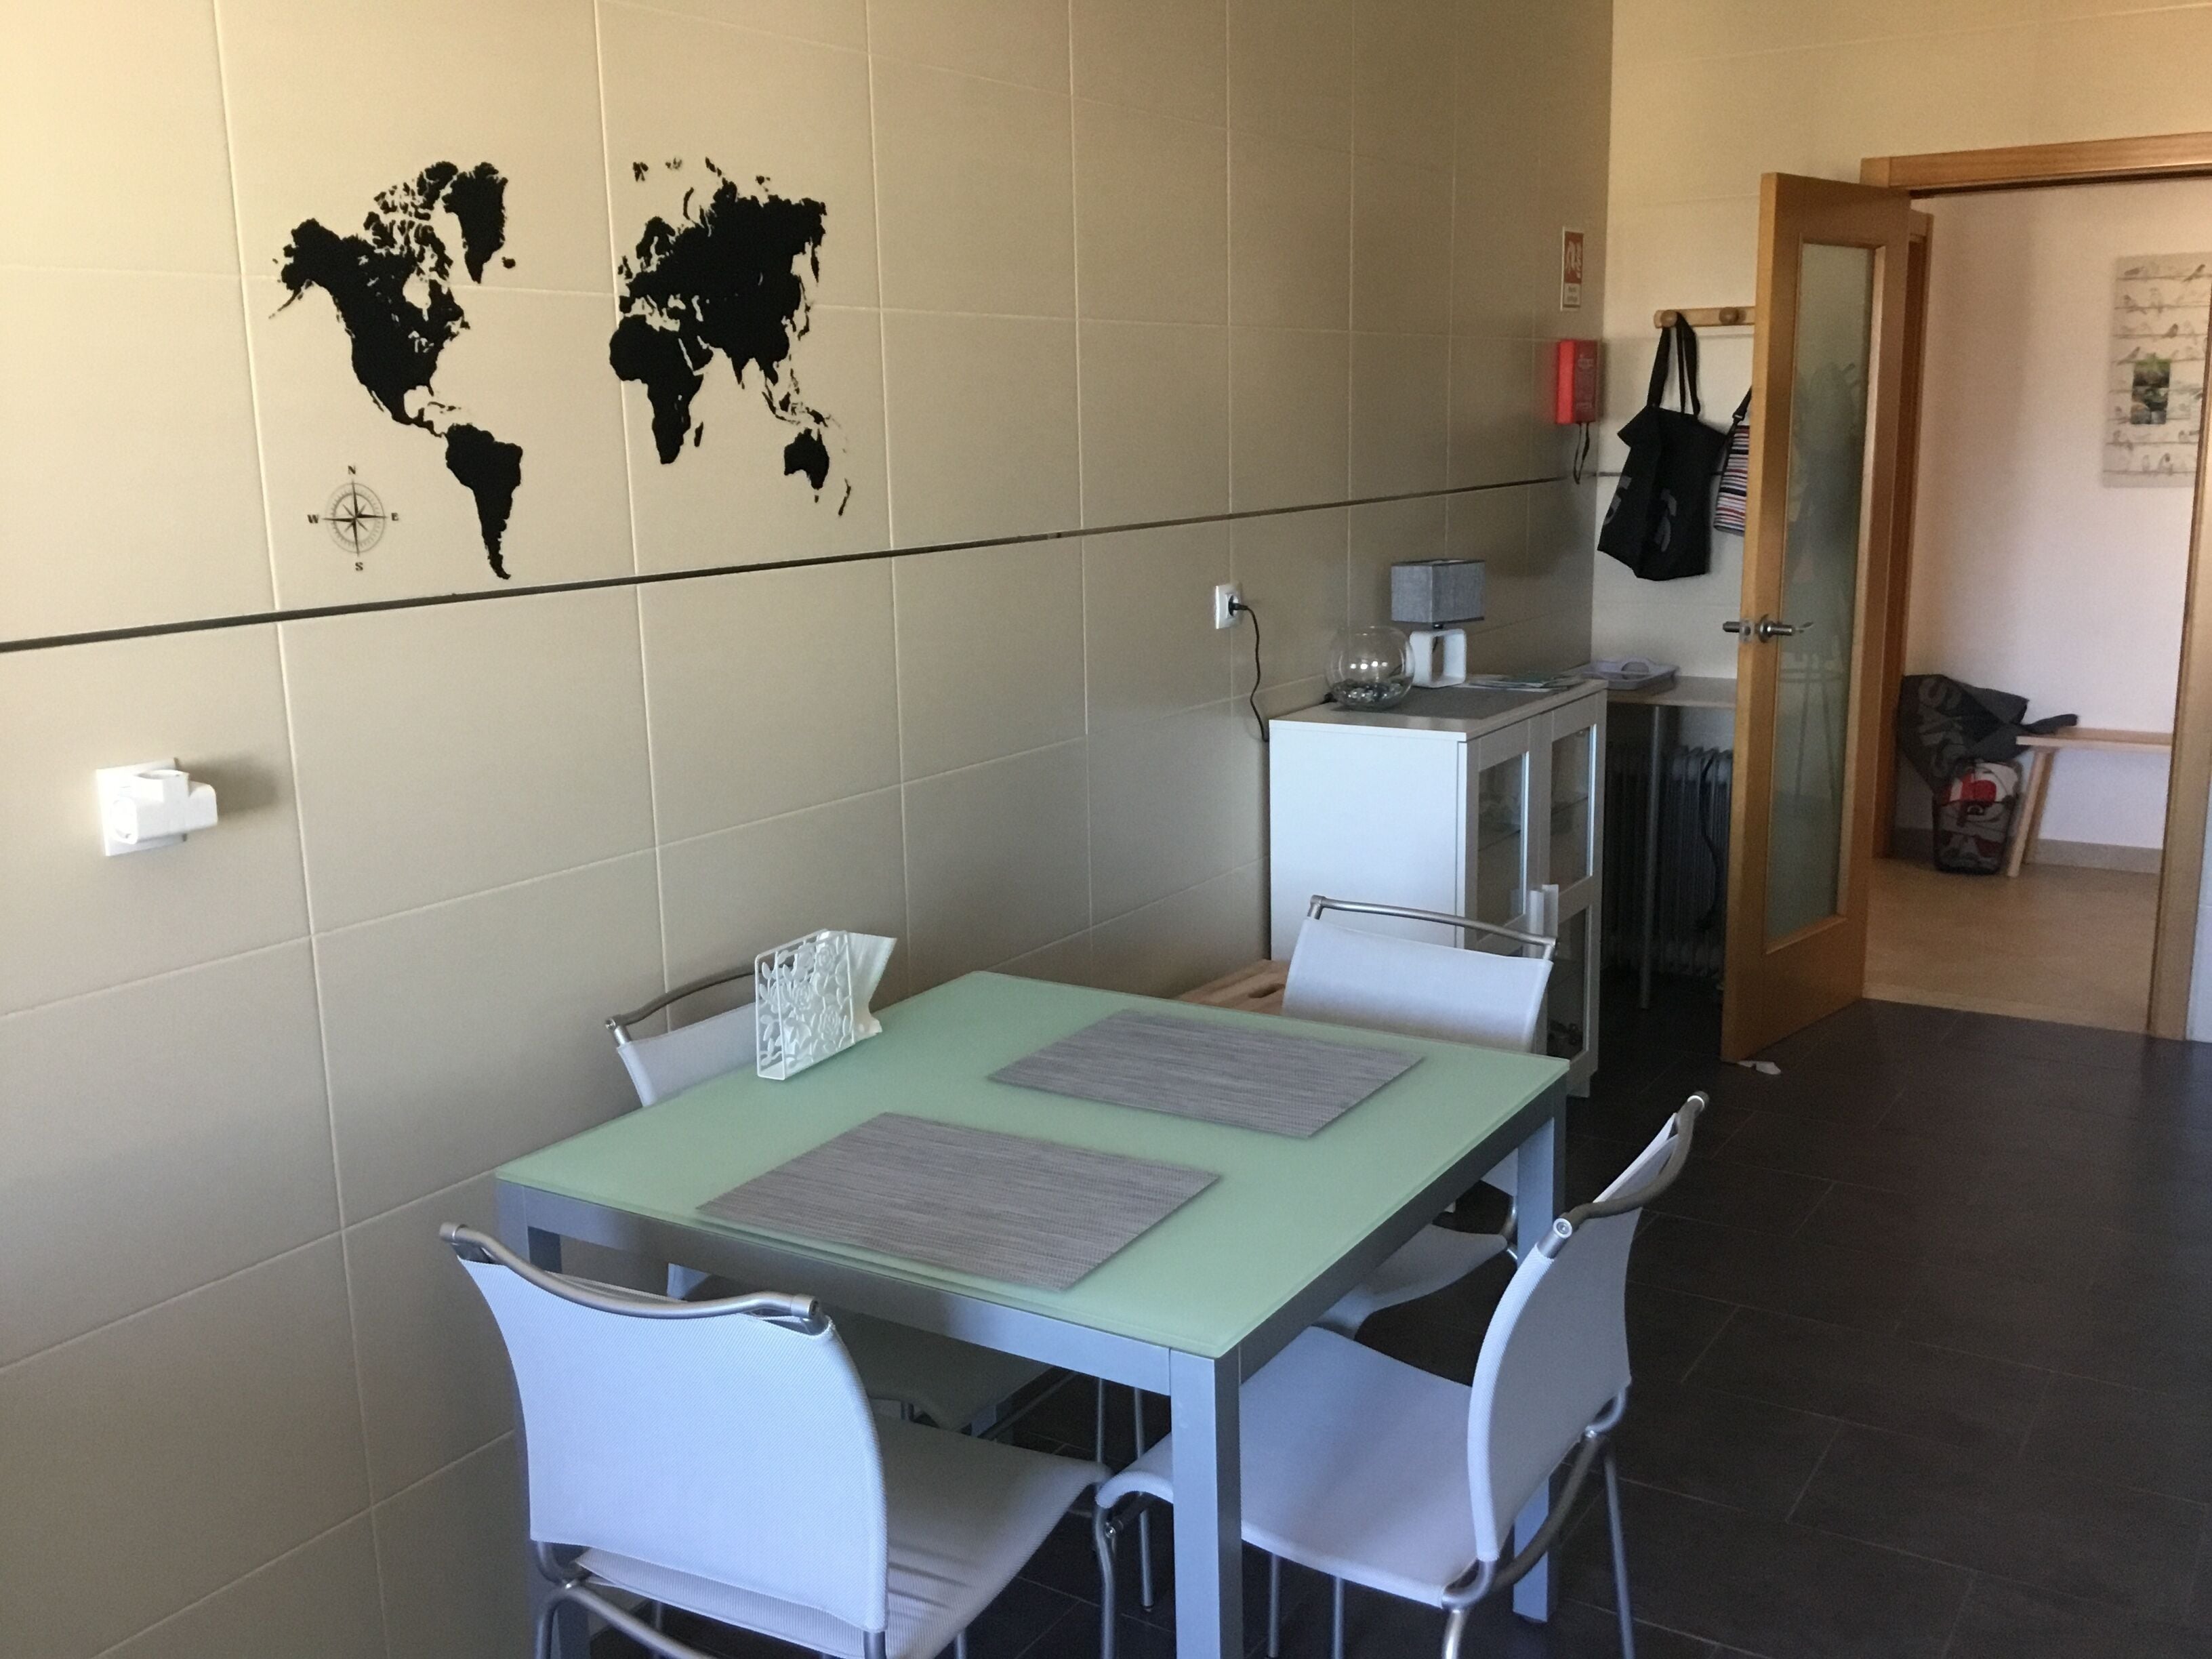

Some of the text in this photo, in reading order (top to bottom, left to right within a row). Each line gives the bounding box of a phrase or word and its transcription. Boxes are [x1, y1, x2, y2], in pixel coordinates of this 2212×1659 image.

[348, 465, 356, 475] N
[307, 514, 319, 524] W
[391, 512, 399, 521] E
[355, 562, 364, 571] S
